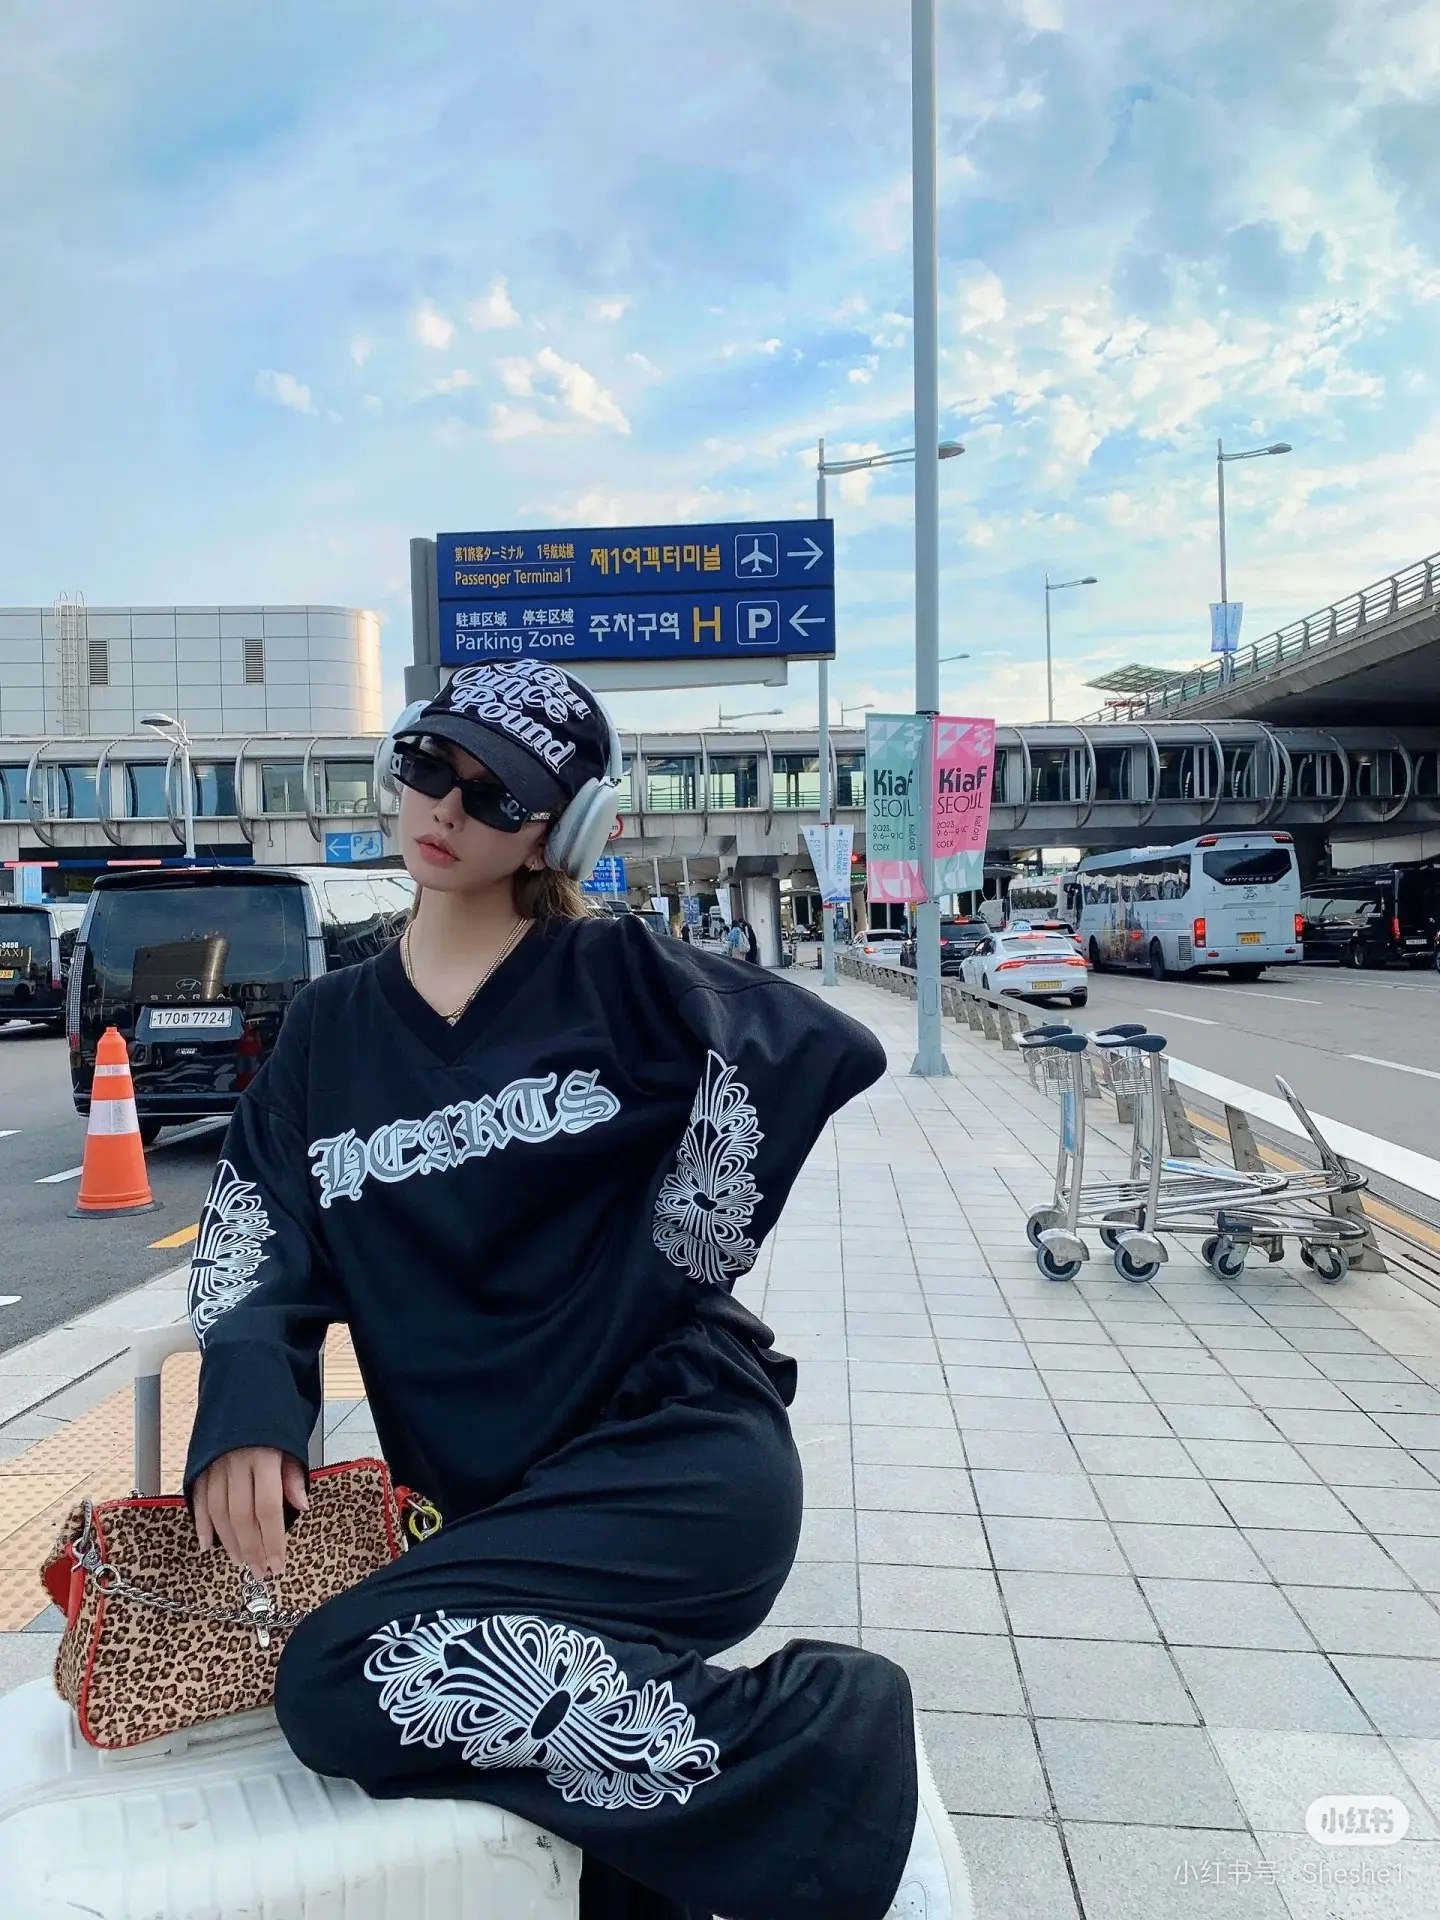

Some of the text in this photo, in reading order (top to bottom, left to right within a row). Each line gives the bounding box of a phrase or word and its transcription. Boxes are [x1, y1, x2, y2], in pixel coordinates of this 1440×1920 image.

[454, 545, 524, 562] 第1旅客ターミナル
[590, 544, 721, 575] 제1여객터미널
[455, 567, 571, 588] Passenger Terminal 1
[456, 611, 507, 627] 駐車区域
[522, 608, 574, 626] 停车区域
[589, 606, 721, 643] 주차구역 H
[748, 608, 772, 639] P
[456, 631, 575, 653] Parking Zone
[450, 685, 576, 775] Pound
[873, 769, 913, 796] Kiaf
[939, 765, 988, 794] Kiaf
[937, 792, 984, 815] SEOUL
[936, 840, 954, 849] COEX
[150, 993, 227, 1001] STARA
[308, 1068, 621, 1209] HEARTS
